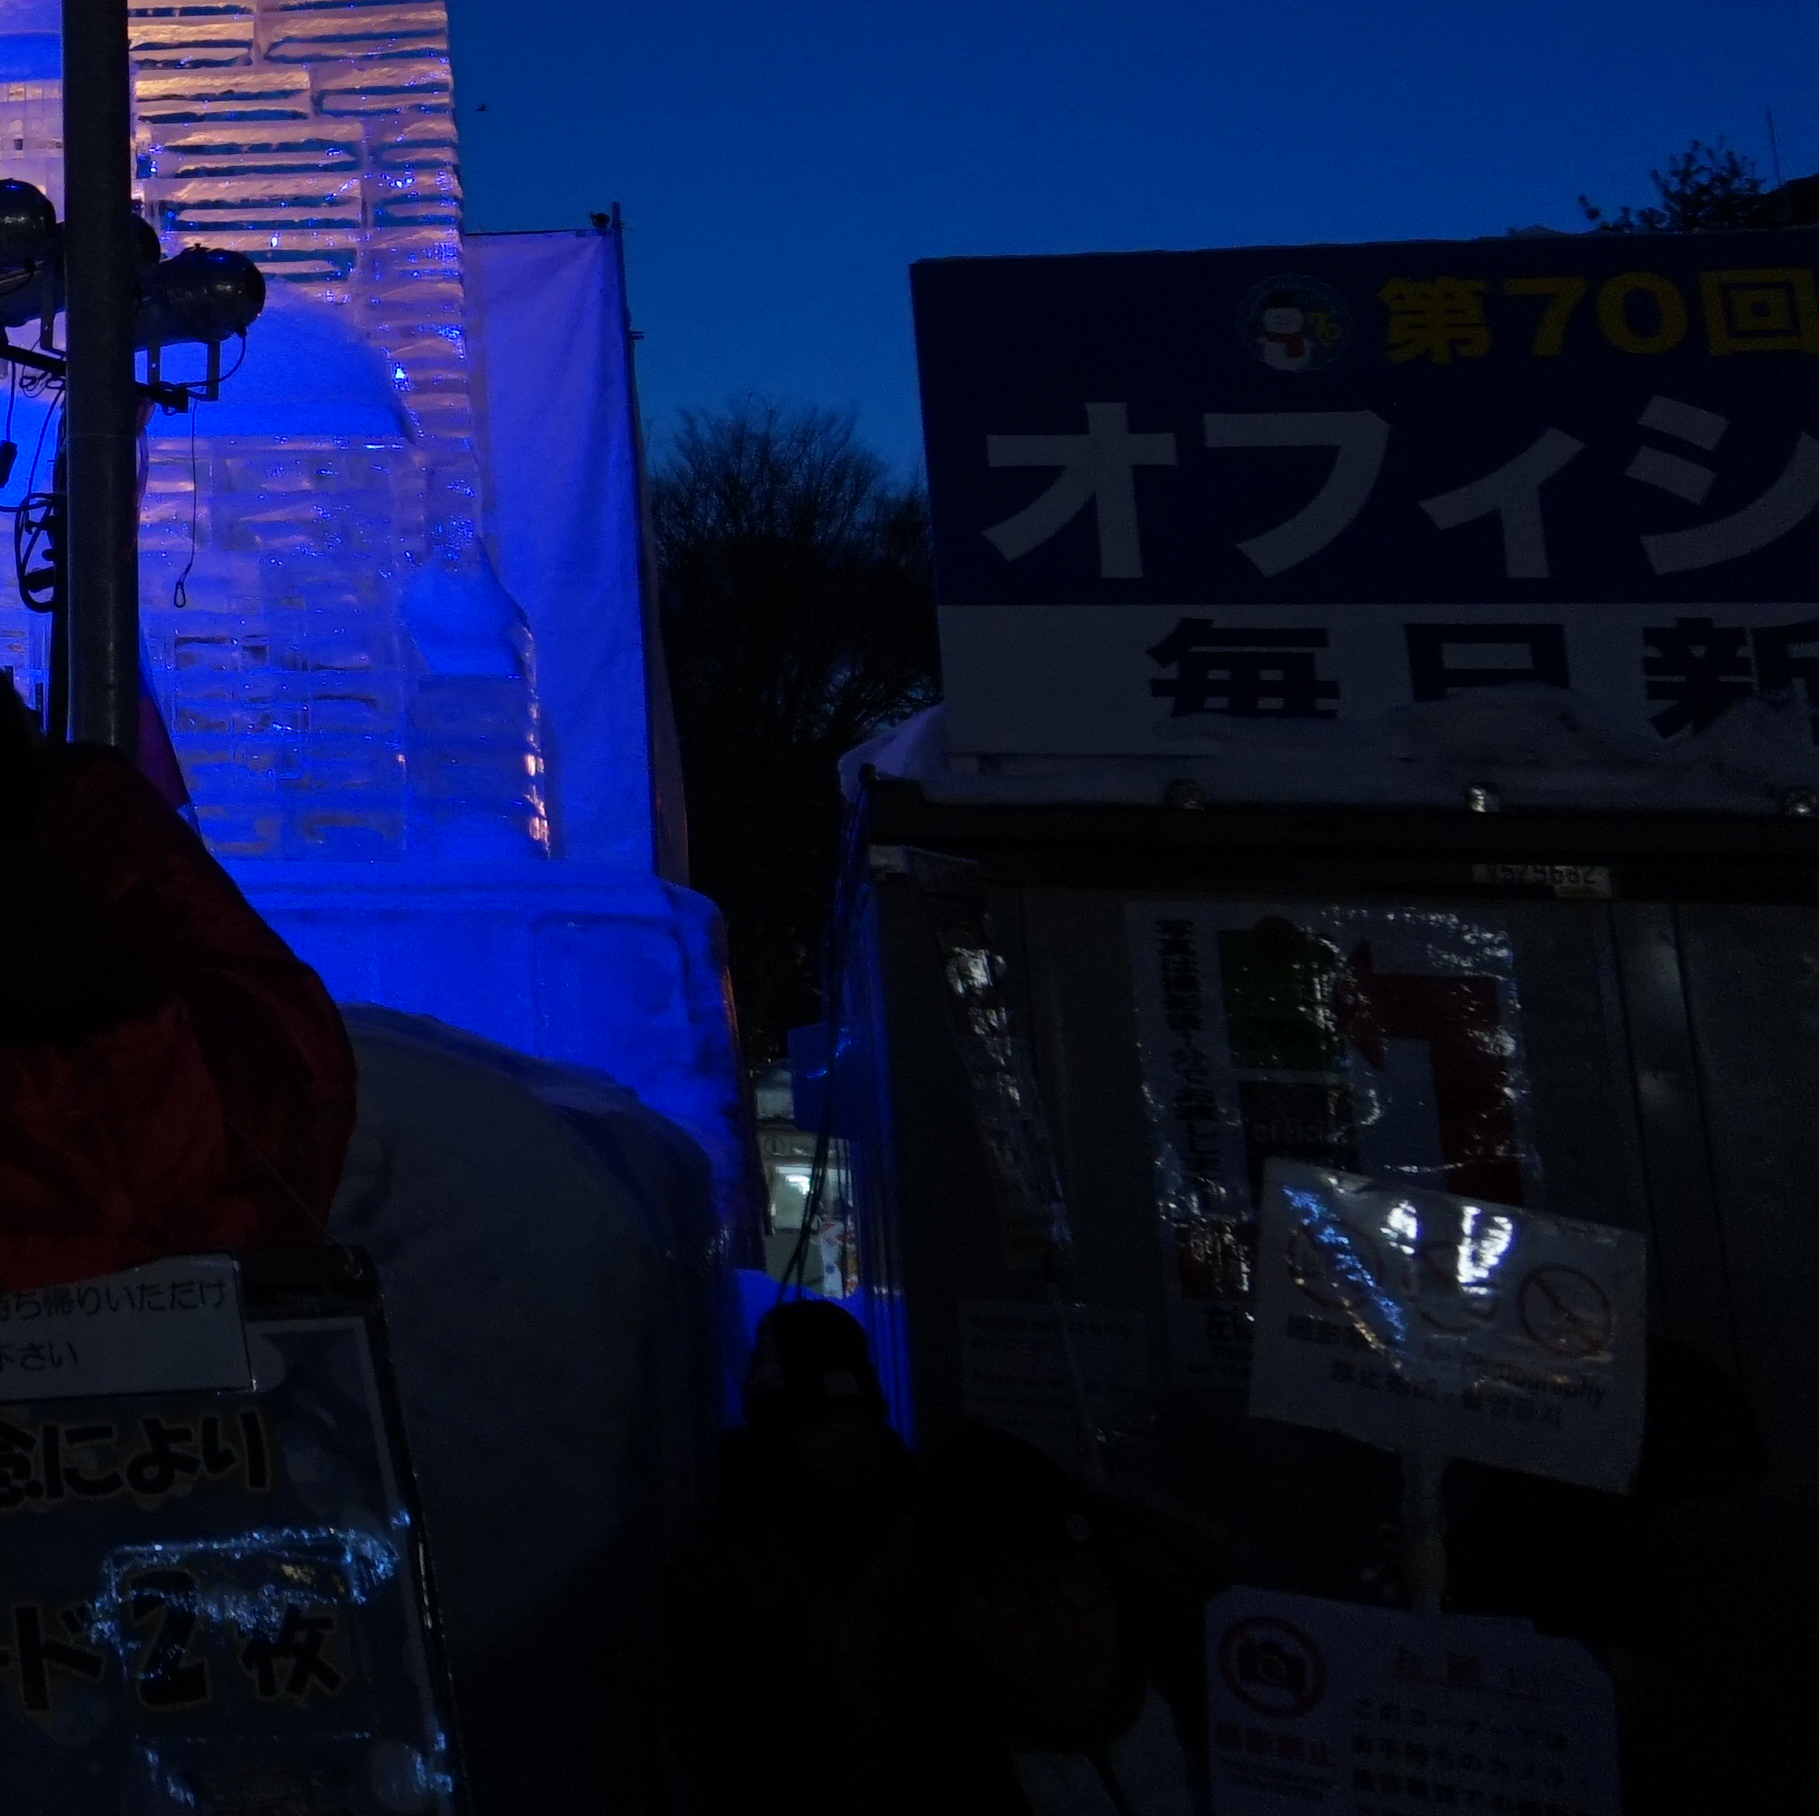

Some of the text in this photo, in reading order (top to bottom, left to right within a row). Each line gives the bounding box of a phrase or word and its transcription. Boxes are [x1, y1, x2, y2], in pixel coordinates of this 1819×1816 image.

[1377, 268, 1819, 364] 第70回
[981, 394, 1819, 580] オフィシ
